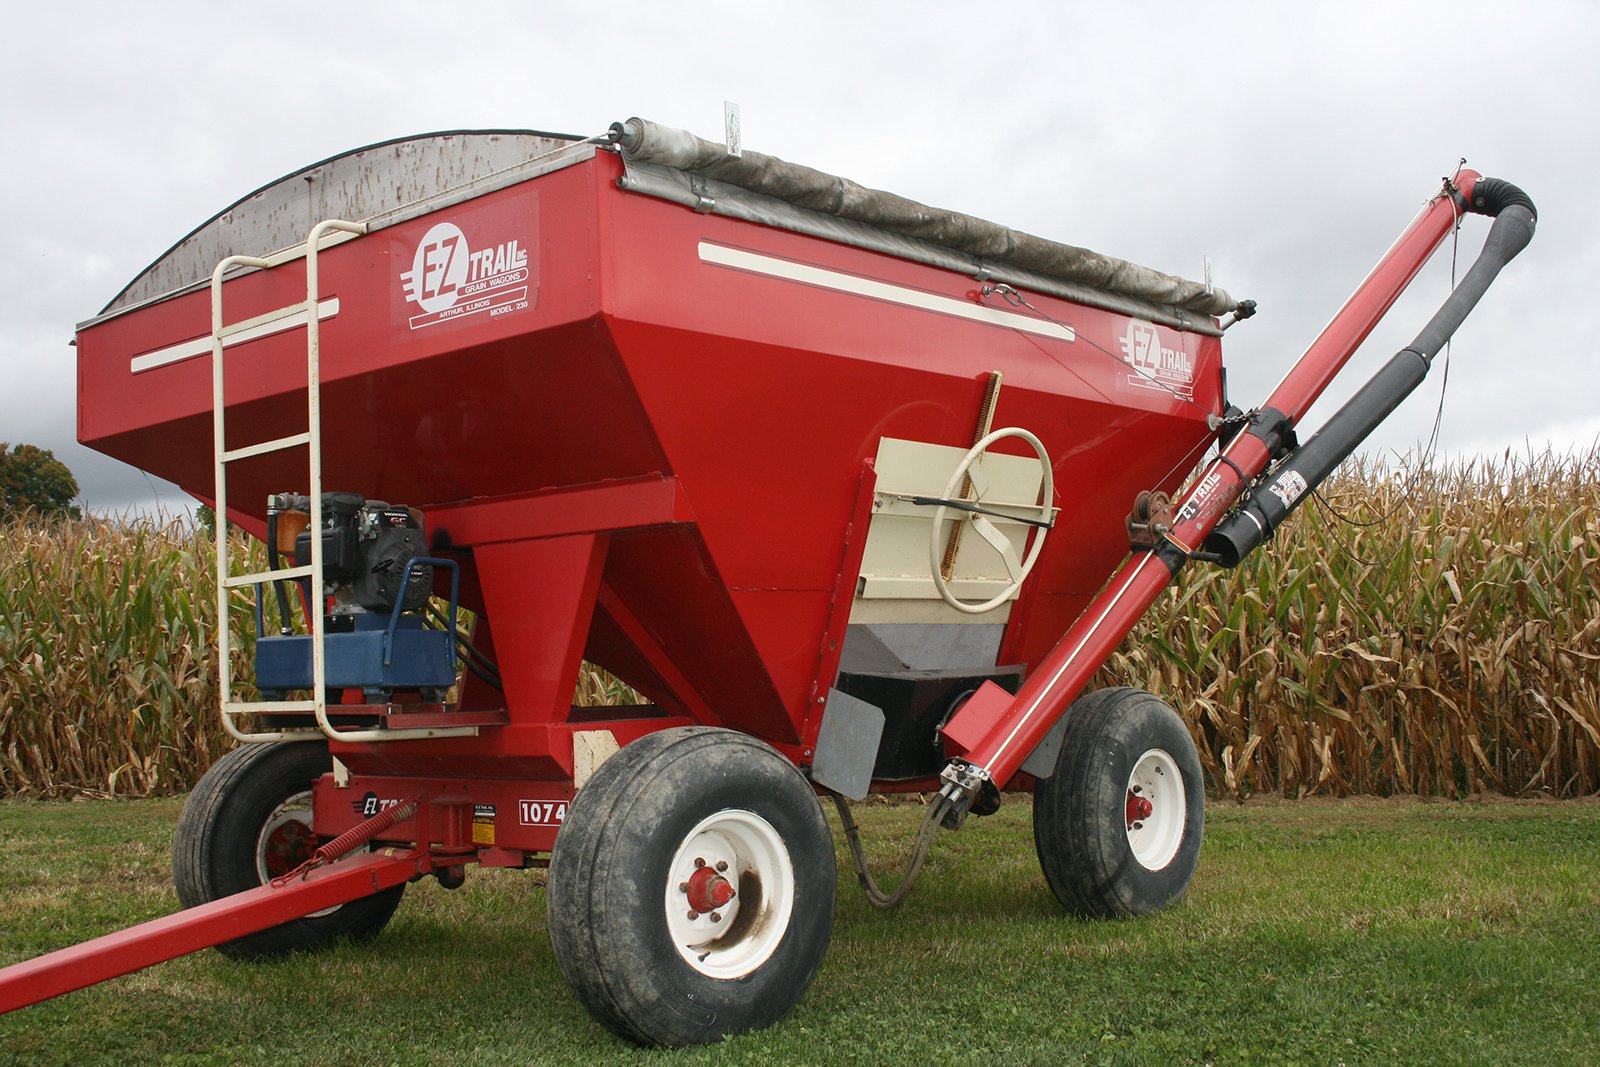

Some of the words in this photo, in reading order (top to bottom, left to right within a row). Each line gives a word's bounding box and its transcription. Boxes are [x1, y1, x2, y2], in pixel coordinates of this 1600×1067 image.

[470, 240, 528, 281] TRAIL
[464, 282, 487, 295] GRAIN
[490, 271, 521, 287] WAGONS
[466, 299, 491, 312] ILLINOIS
[490, 306, 513, 317] MODEL
[516, 300, 529, 310] 230
[1161, 347, 1192, 374] TRAIL
[522, 803, 565, 823] 1074
